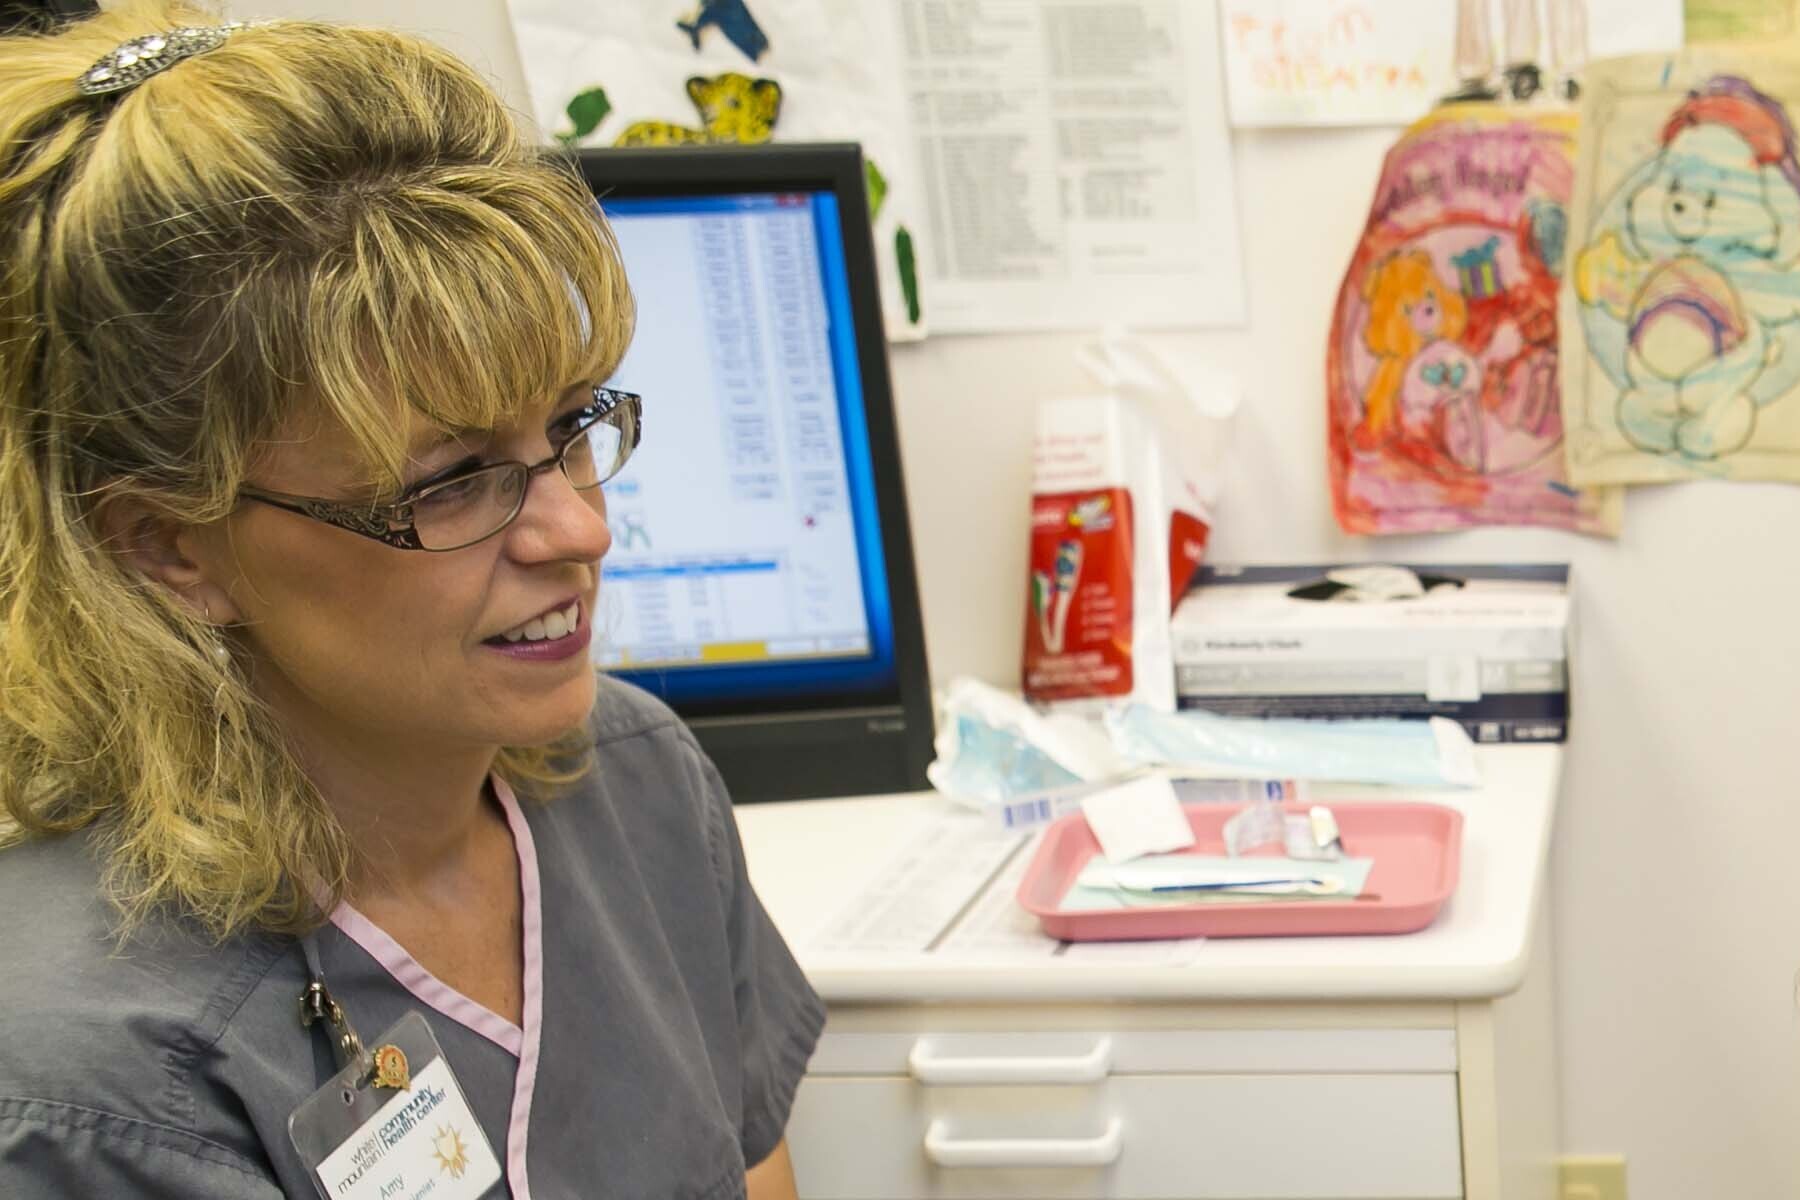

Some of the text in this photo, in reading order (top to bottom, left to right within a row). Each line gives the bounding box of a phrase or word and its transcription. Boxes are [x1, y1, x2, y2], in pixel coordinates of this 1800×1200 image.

[379, 1085, 433, 1137] community
[383, 1088, 448, 1150] health center
[337, 1151, 383, 1194] mountain
[351, 1138, 376, 1166] white
